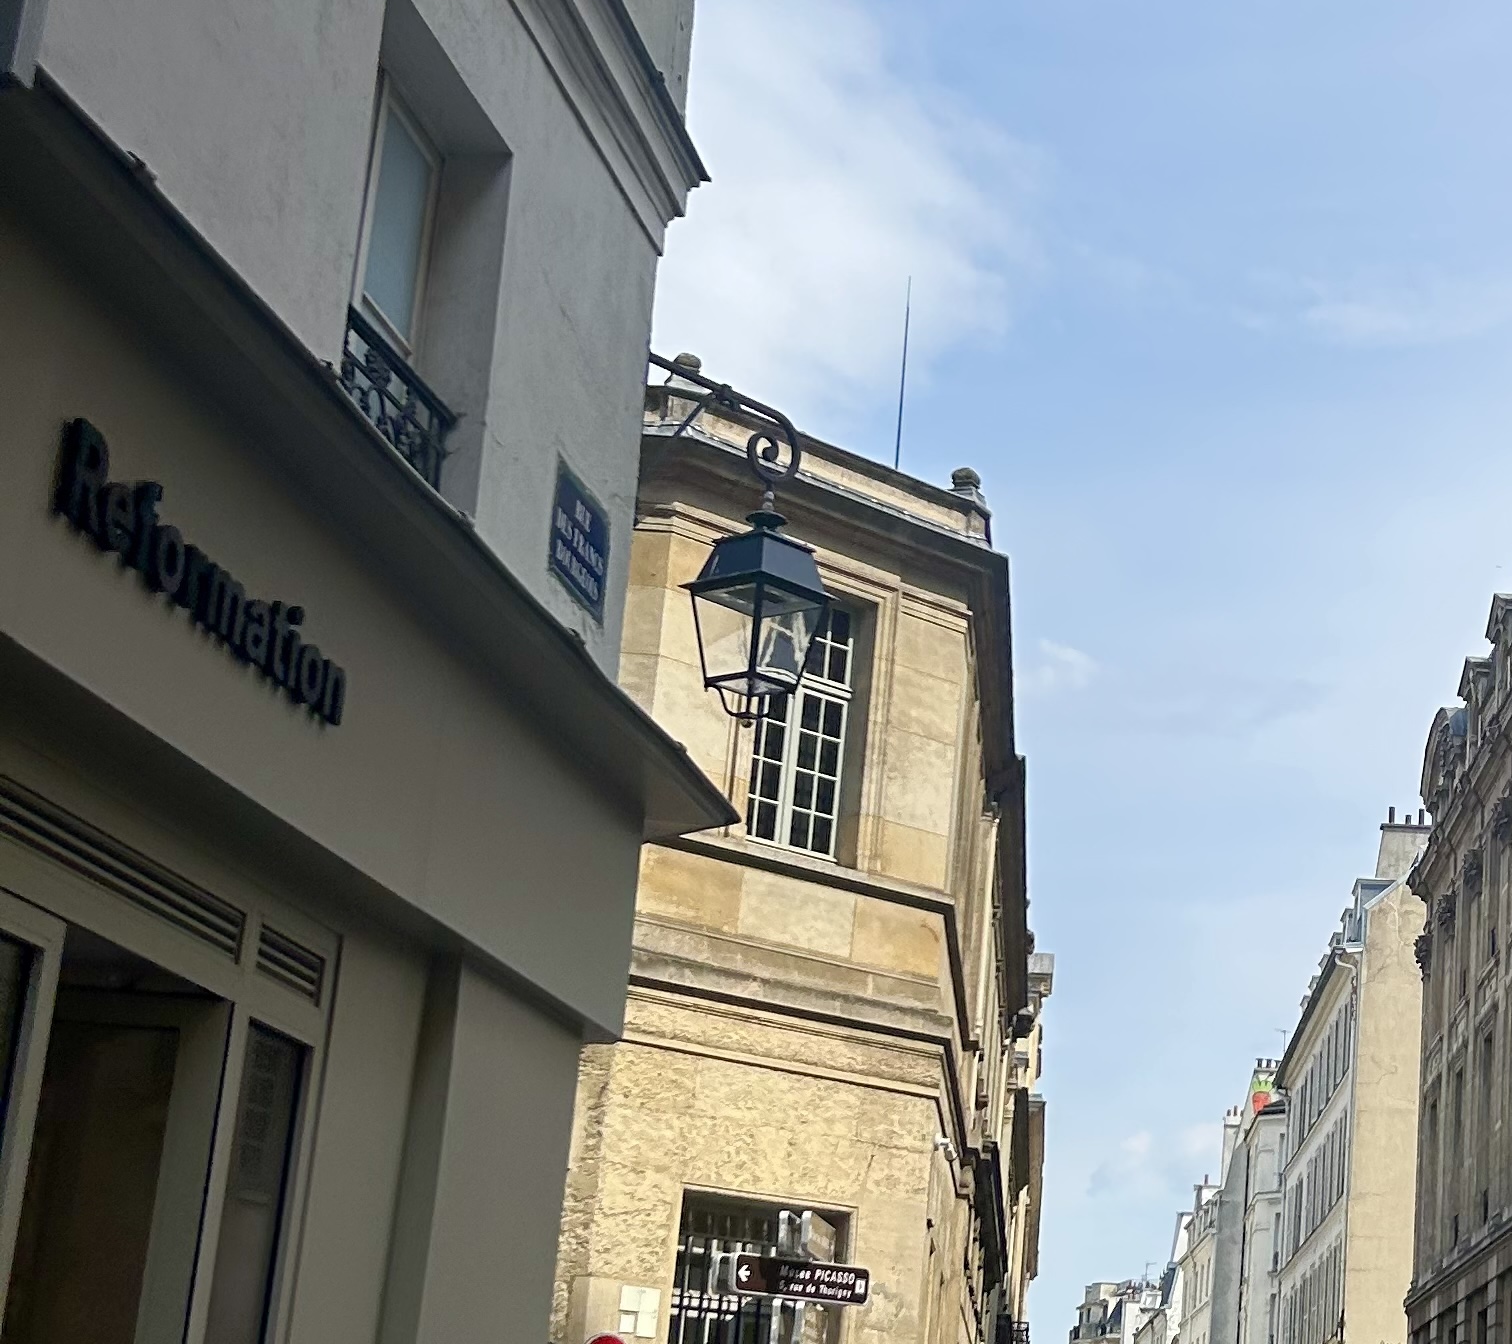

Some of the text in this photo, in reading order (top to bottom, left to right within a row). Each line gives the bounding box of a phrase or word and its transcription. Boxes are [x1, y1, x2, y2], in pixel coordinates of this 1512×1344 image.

[53, 417, 346, 725] Reformation
[814, 1268, 856, 1285] PICASSO
[789, 1283, 804, 1293] rue
[805, 1282, 817, 1293] de
